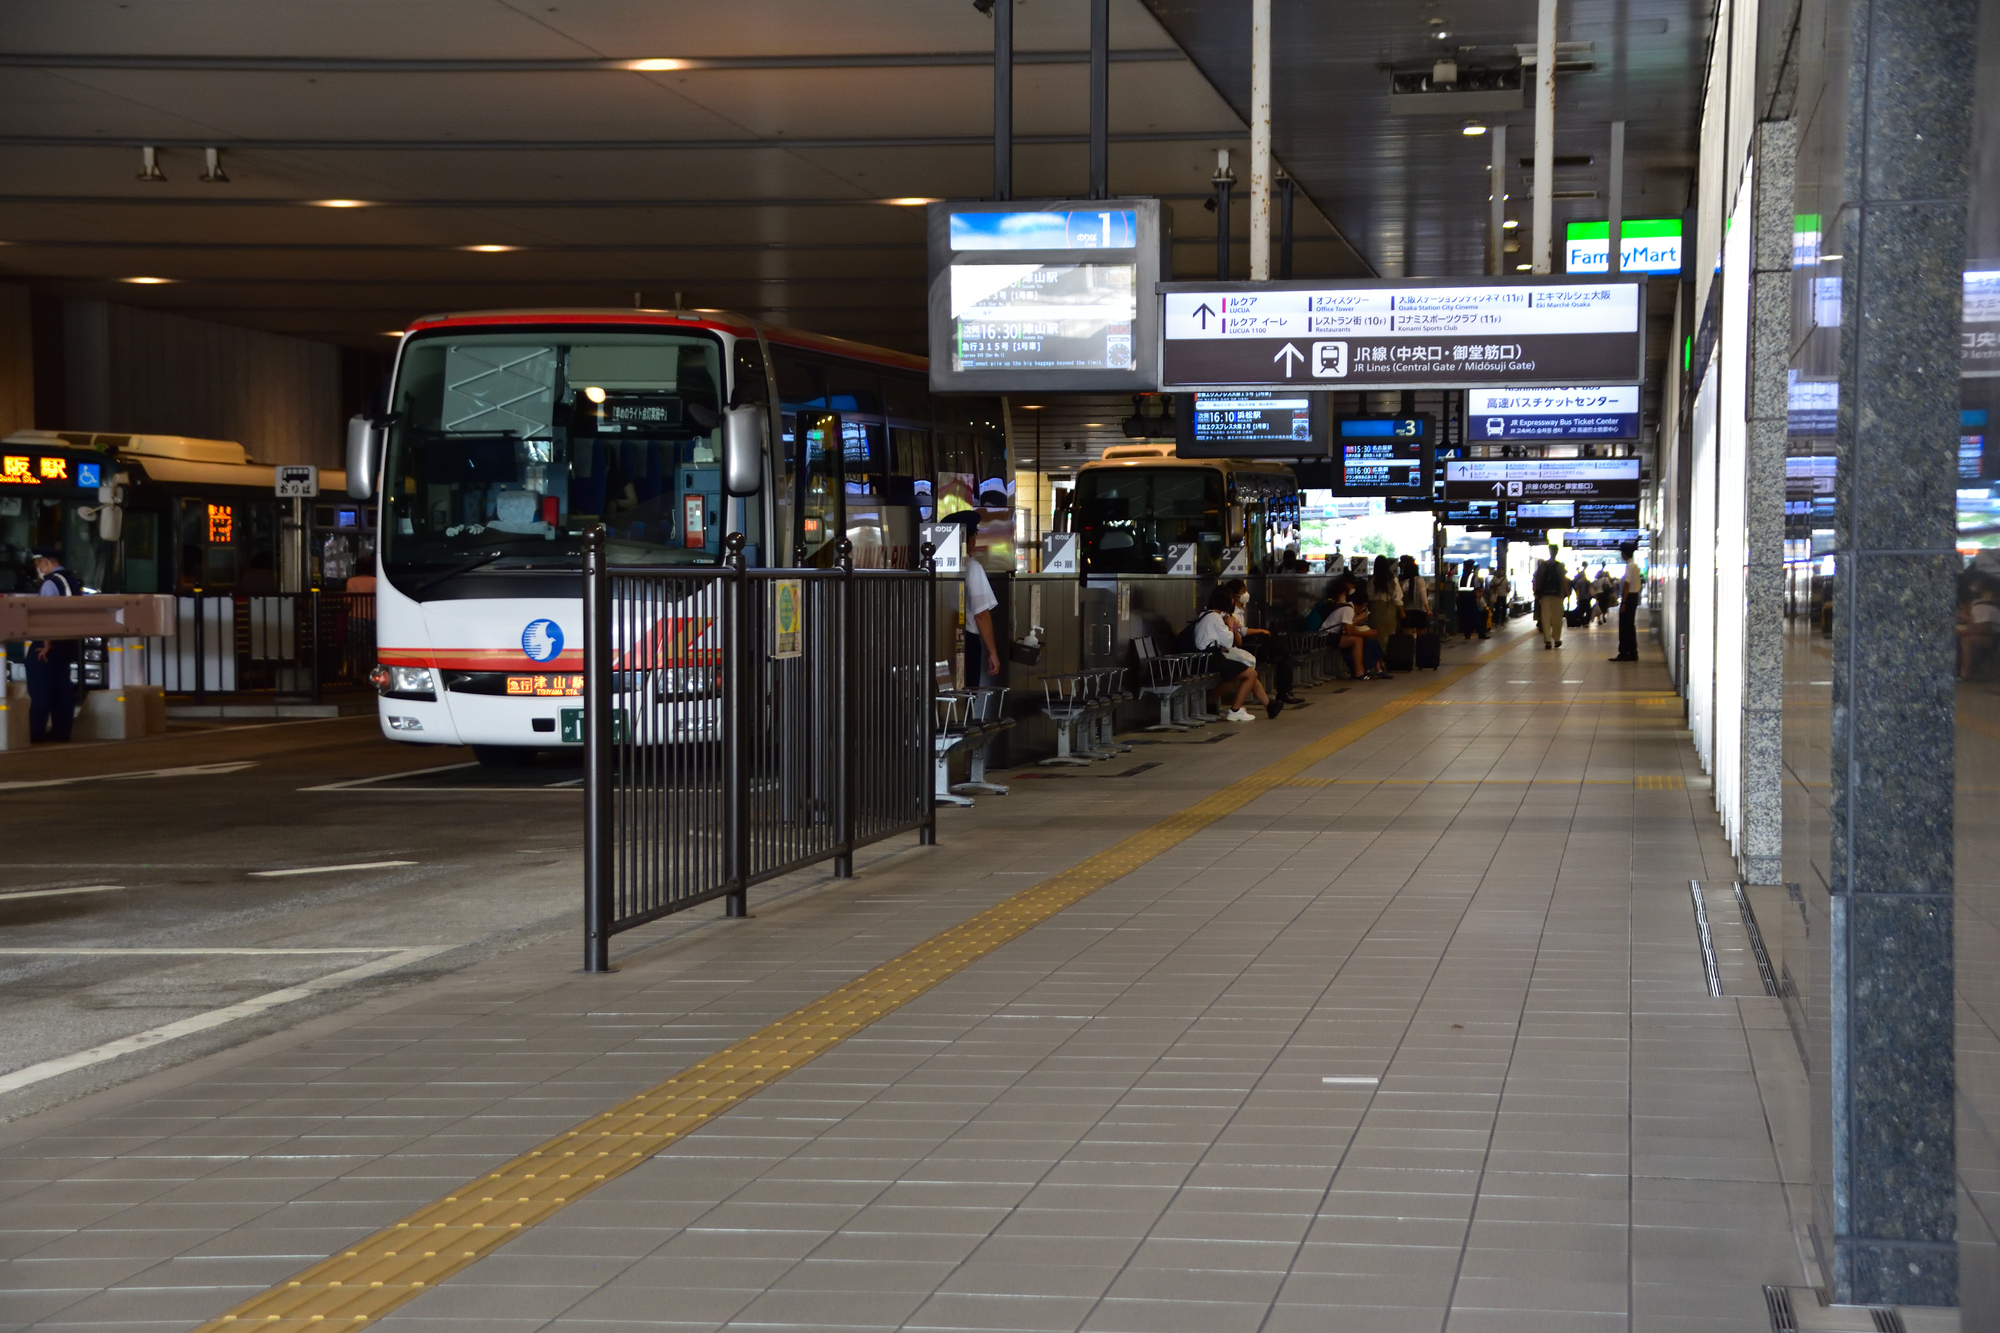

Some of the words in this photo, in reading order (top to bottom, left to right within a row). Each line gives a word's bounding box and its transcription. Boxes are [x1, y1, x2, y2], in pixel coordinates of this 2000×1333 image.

[1098, 212, 1111, 248] 1
[1077, 233, 1097, 242] のりば
[1571, 246, 1677, 268] FamyMart
[1316, 296, 1369, 305] オフィスタワー
[1536, 290, 1611, 301] エキマルシェ大阪
[1230, 297, 1257, 307] ルクア
[1229, 317, 1257, 327] ルクア
[1261, 317, 1287, 326] イーレ
[1316, 316, 1361, 326] レストラン街
[1398, 314, 1477, 324] コナミスポーツクラブ
[981, 323, 1018, 339] 16:30
[1023, 323, 1058, 334] 津山駅
[1354, 363, 1364, 372] JR
[1367, 363, 1391, 372] Lines
[1393, 362, 1430, 373] (Central
[1432, 362, 1455, 372] Gate
[1458, 362, 1463, 371] /
[1508, 360, 1535, 371] Gate)
[1487, 395, 1619, 409] 高速バスチケットセンター
[1209, 412, 1235, 423] 16:10
[1519, 419, 1558, 427] Expressway
[1596, 417, 1619, 425] Center
[1405, 419, 1416, 436] 3
[1445, 449, 1455, 458] 4
[280, 484, 311, 494] おりば
[922, 527, 932, 542] 1
[935, 525, 953, 533] のりば
[1044, 535, 1052, 552] 1
[1168, 544, 1178, 558] 2
[1222, 548, 1231, 560] 2
[934, 557, 957, 567] 前扉
[1054, 560, 1073, 568] 中扉
[510, 680, 530, 691] 急行
